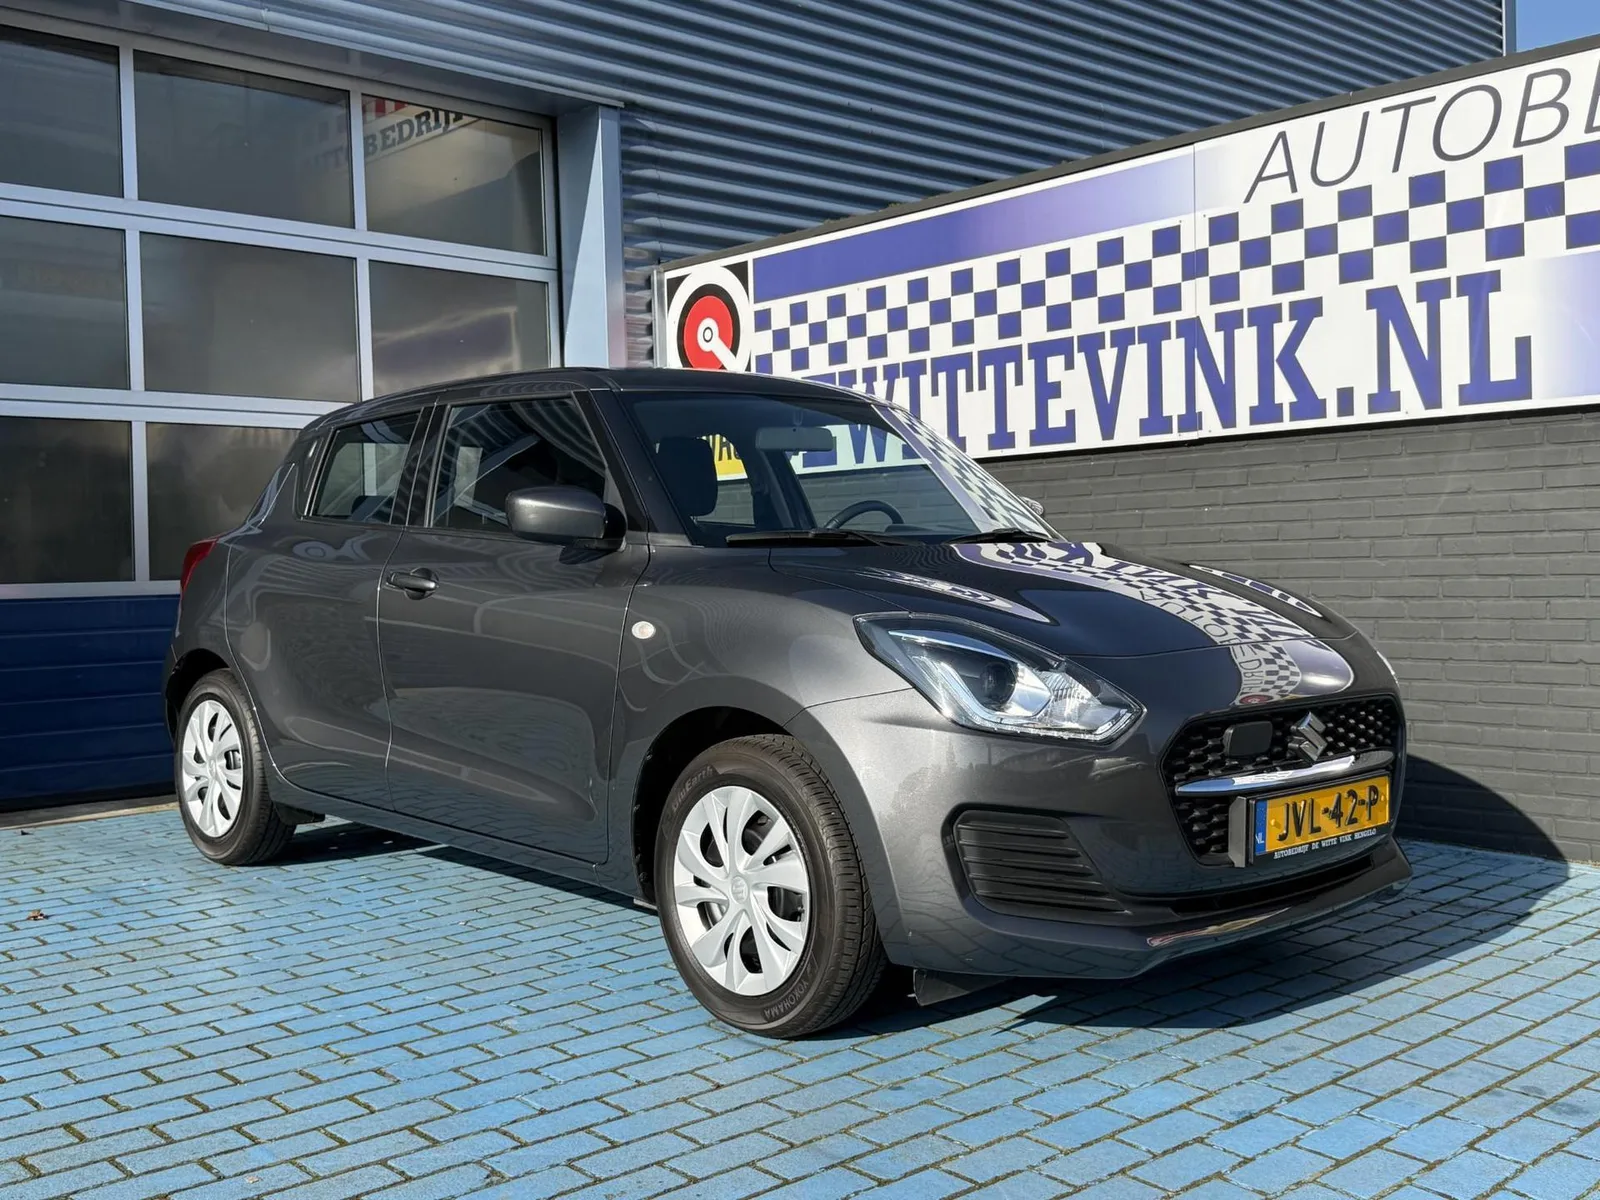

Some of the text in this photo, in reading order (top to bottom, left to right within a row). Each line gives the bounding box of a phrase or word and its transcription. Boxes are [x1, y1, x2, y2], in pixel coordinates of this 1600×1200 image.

[1243, 60, 1600, 204] AUTOB
[1277, 785, 1379, 842] JVL-42-P
[763, 979, 809, 1020] YOKOHAMA
